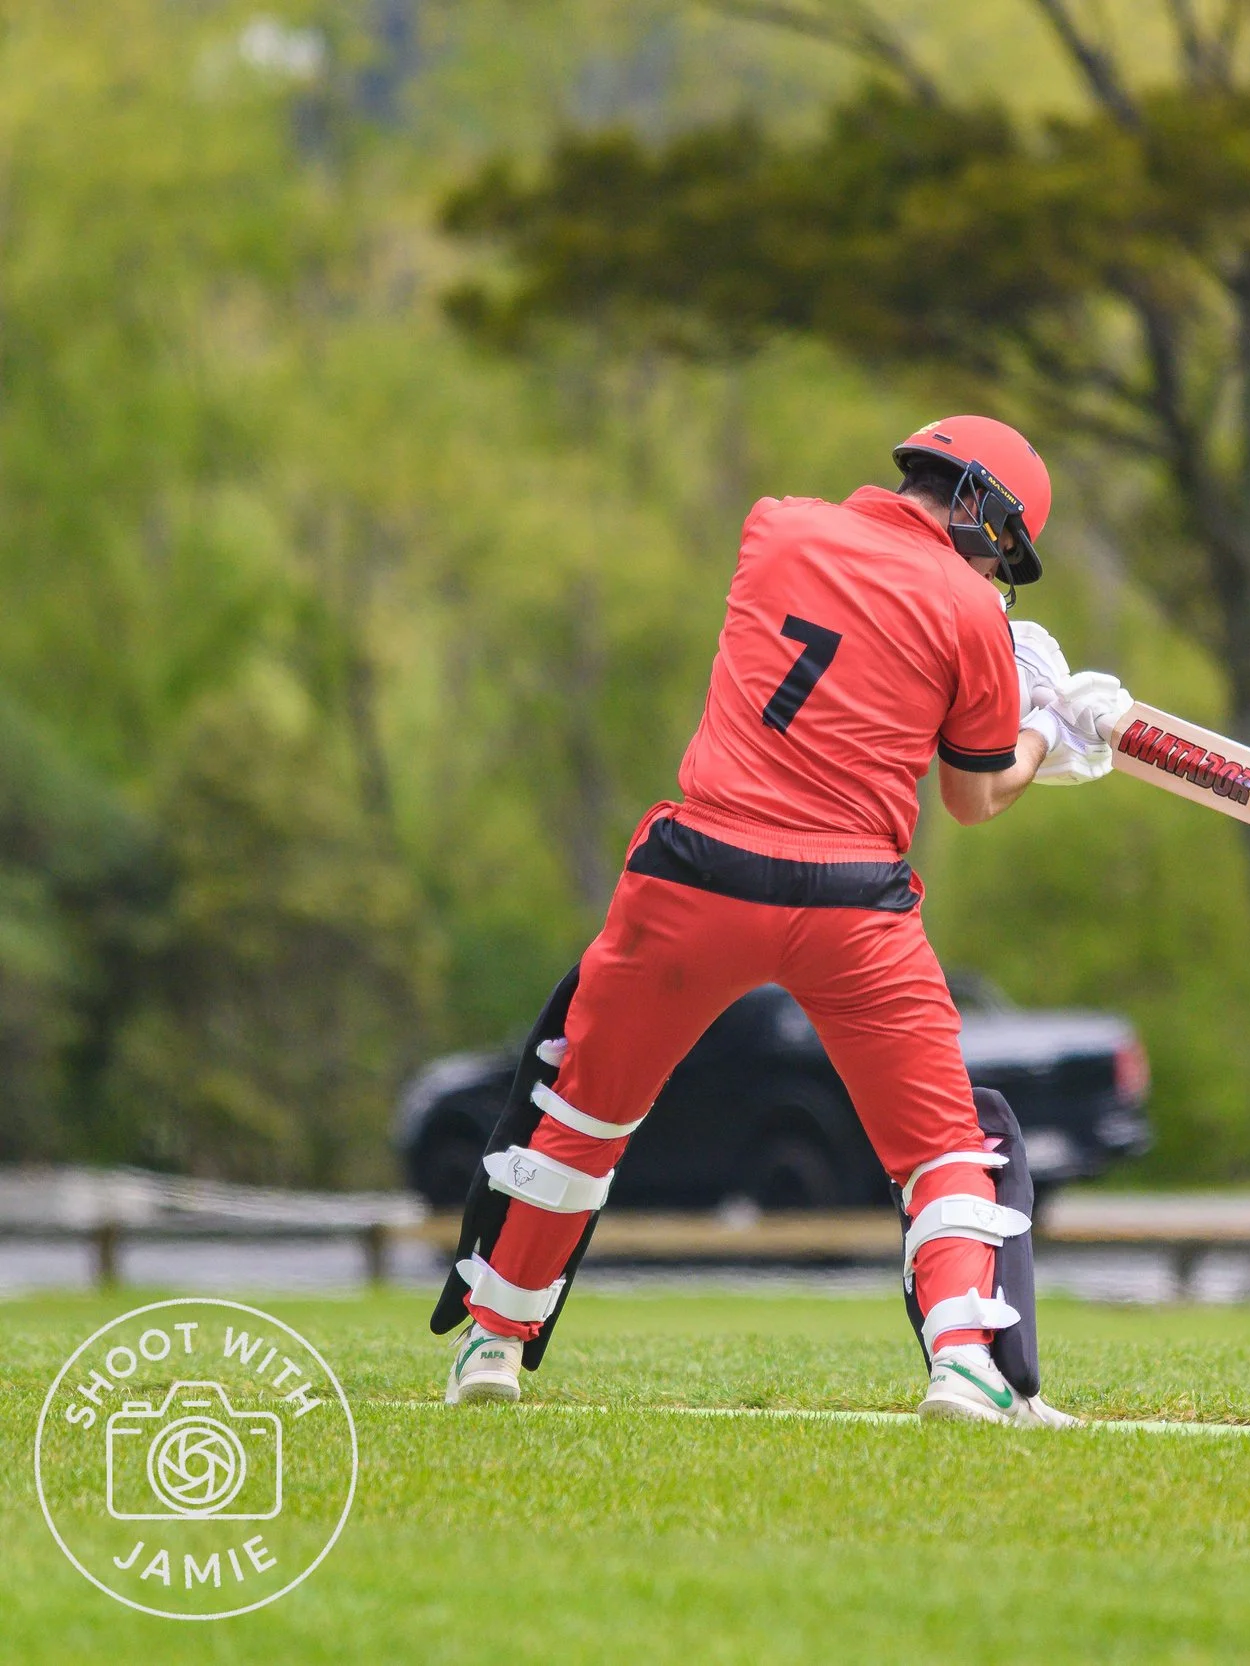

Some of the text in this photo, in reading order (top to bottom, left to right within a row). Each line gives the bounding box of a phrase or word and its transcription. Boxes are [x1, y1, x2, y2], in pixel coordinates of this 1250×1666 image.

[988, 476, 1017, 505] MASURI
[763, 614, 843, 735] 7
[480, 1351, 505, 1360] RAFA
